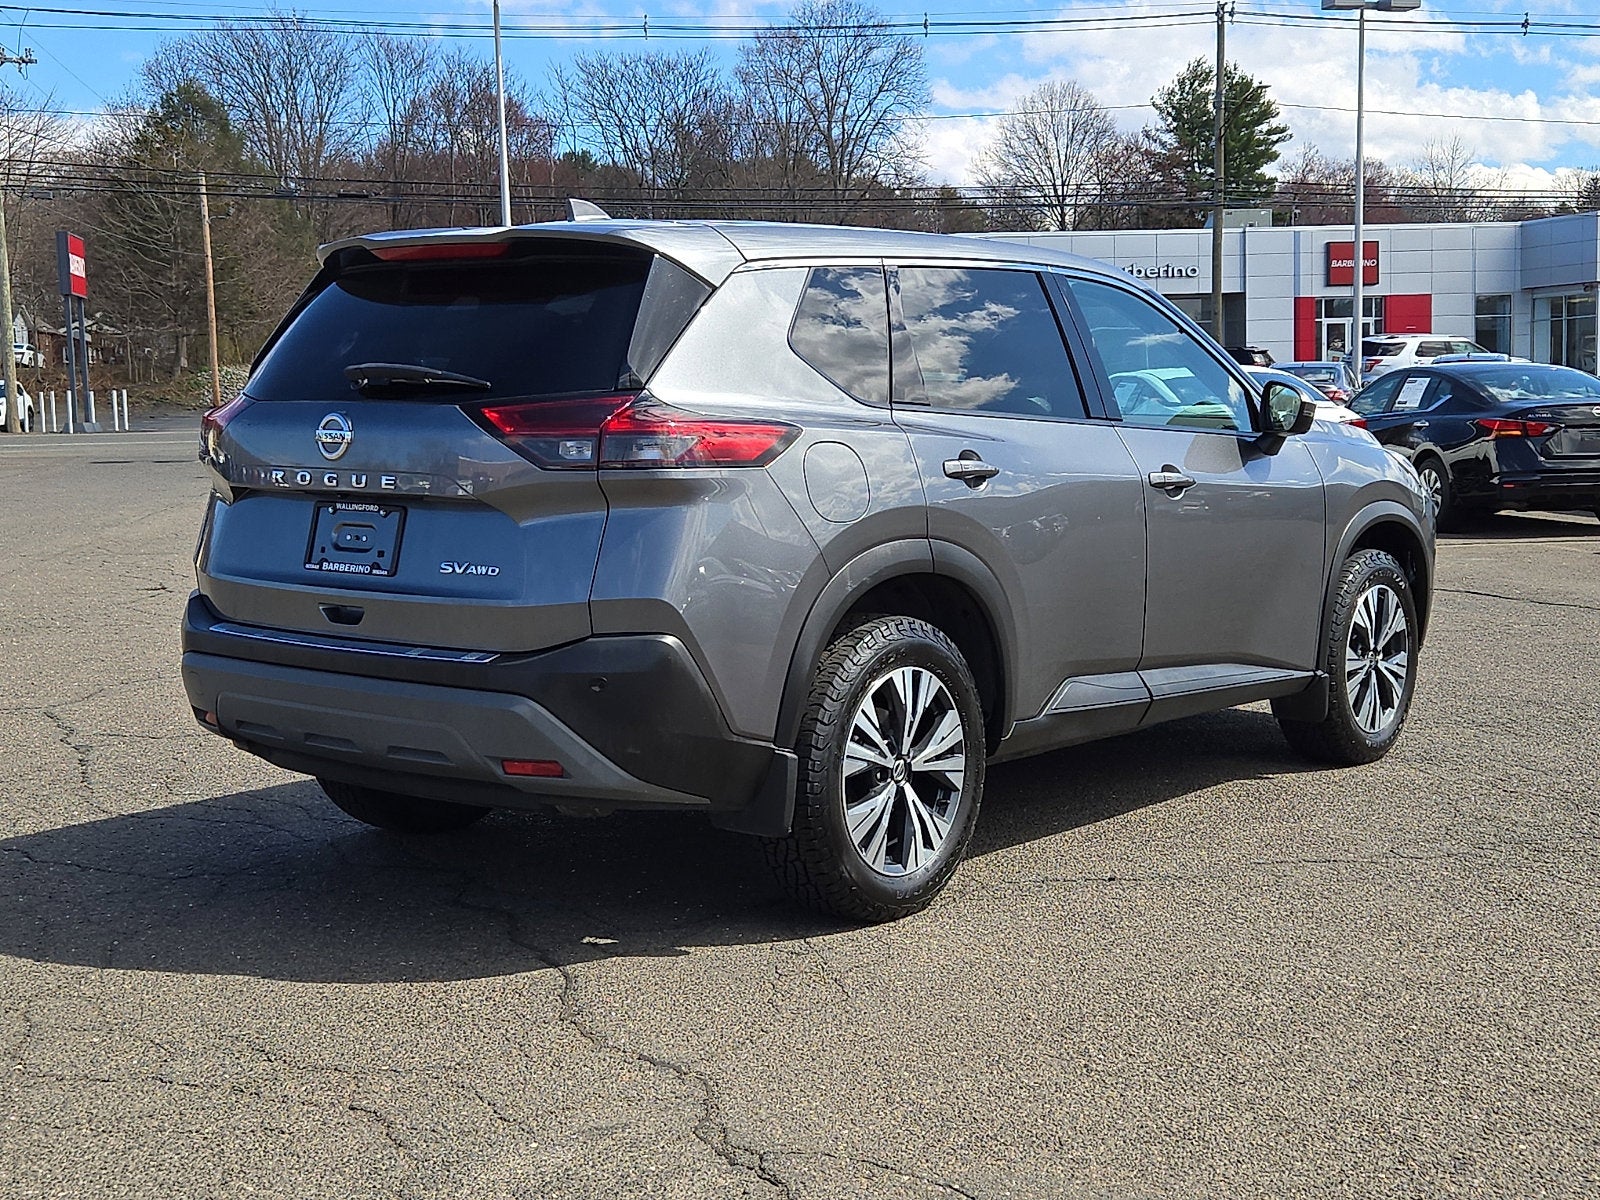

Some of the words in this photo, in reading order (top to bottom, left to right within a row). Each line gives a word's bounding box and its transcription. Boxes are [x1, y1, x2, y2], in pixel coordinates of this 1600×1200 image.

[1122, 263, 1200, 278] rberino
[316, 431, 347, 442] NISSAN
[271, 470, 397, 489] ROGUE
[335, 502, 380, 512] WALLINGFORD
[321, 561, 371, 574] BARBERINO
